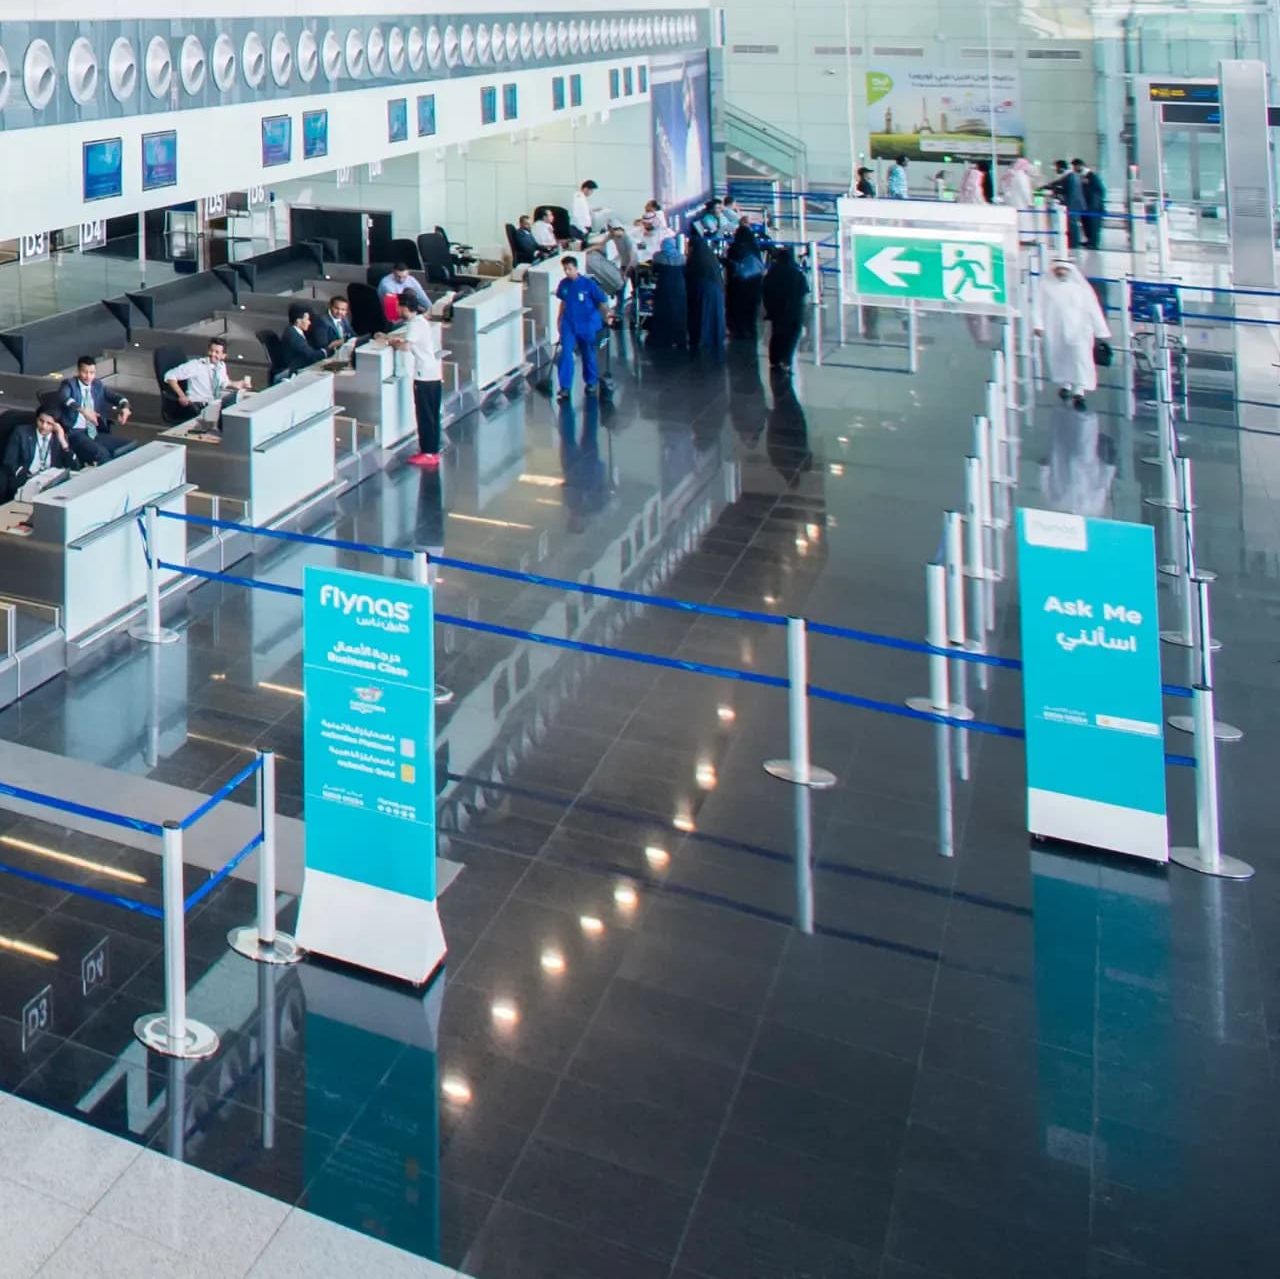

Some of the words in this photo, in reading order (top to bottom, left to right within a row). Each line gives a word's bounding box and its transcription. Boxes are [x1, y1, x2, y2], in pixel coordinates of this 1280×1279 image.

[209, 194, 223, 214] D5
[25, 233, 45, 257] D3
[83, 221, 101, 243] D4
[320, 584, 410, 622] flynas
[1043, 595, 1094, 619] Ask
[1103, 602, 1143, 626] Me
[1055, 626, 1138, 653] اسألني
[327, 651, 377, 671] Business
[377, 662, 409, 677] Class
